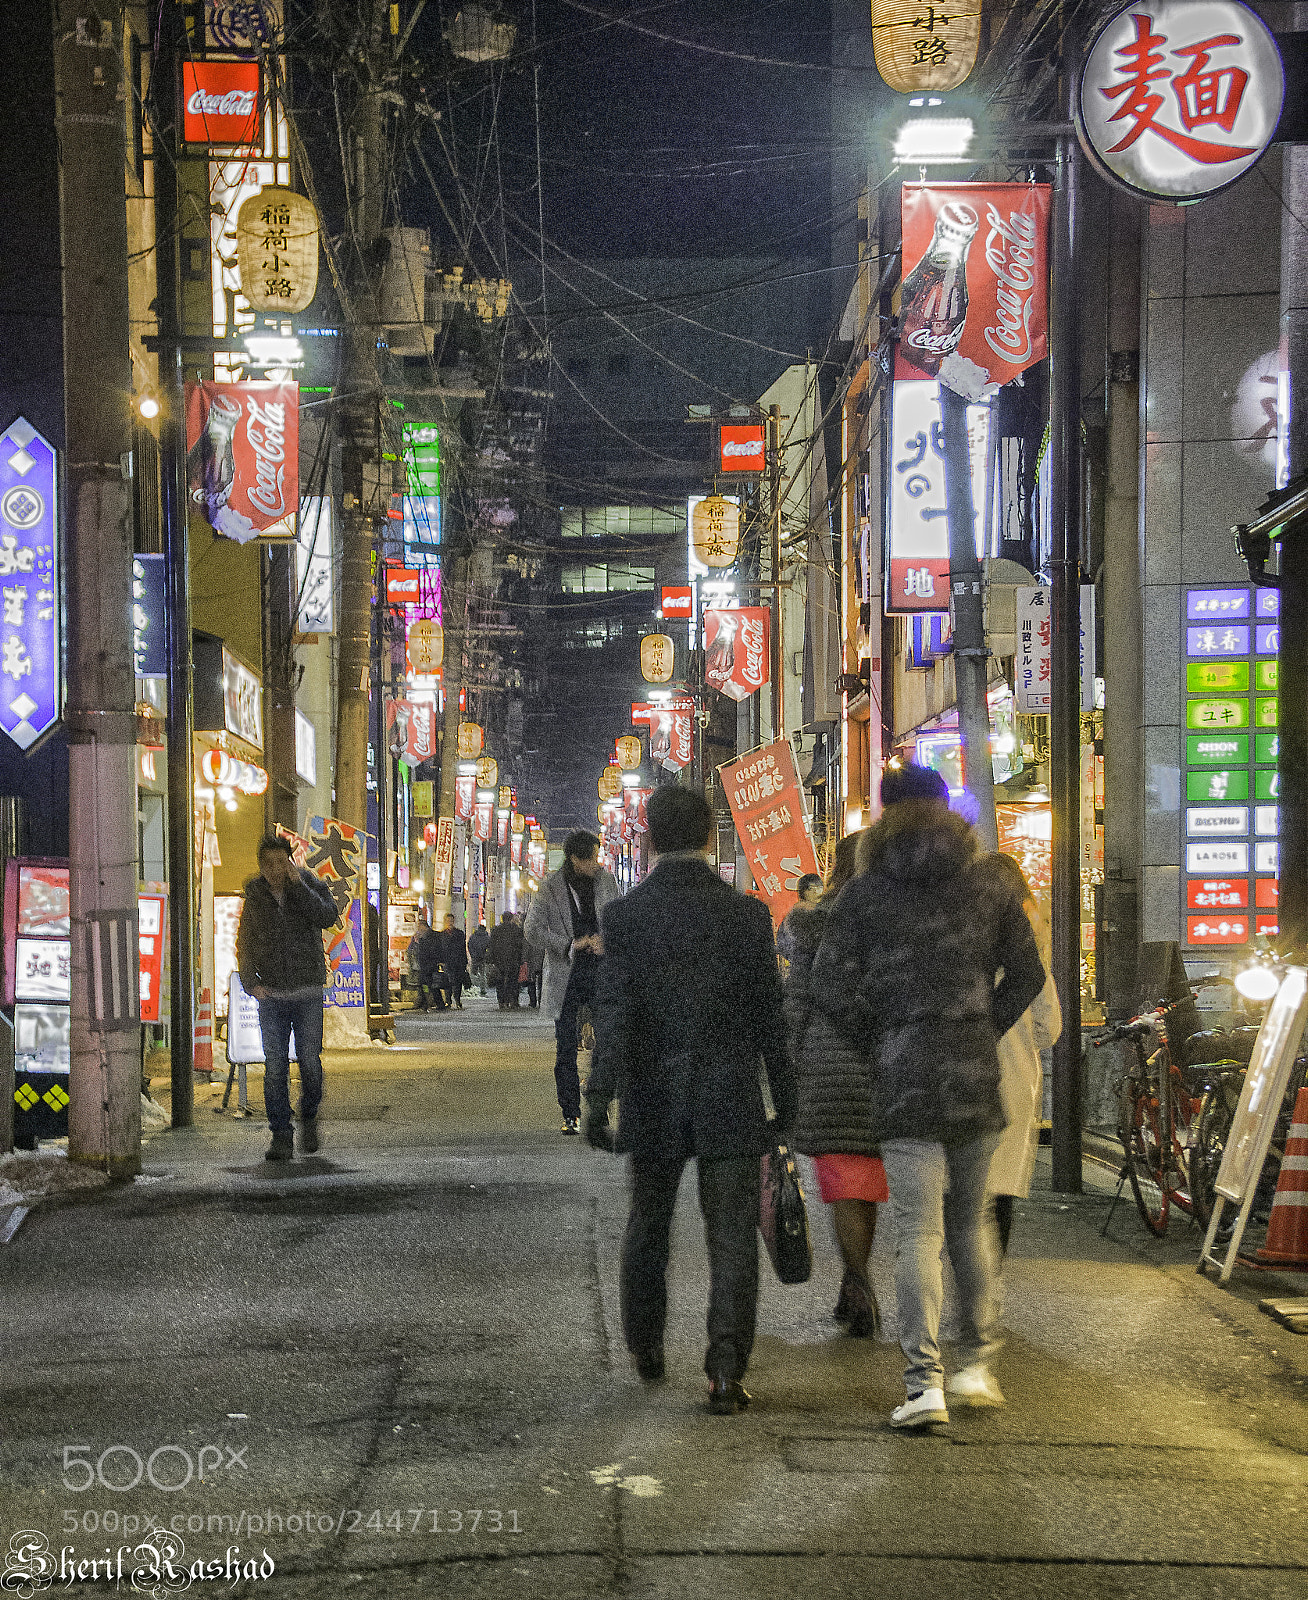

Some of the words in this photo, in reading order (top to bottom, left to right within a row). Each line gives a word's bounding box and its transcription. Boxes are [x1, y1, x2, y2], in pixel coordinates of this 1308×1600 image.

[912, 0, 953, 66] 小路
[187, 89, 257, 116] Coca-Cola
[1099, 14, 1259, 164] 麺
[260, 203, 295, 299] 稲荷小路
[984, 202, 1037, 364] Coca-Cola
[246, 395, 286, 518] Coca-Cola
[723, 441, 764, 457] Coca-Cola
[706, 504, 725, 557] 稲荷小路
[904, 567, 935, 598] 地
[1195, 597, 1245, 612] スキップ
[740, 615, 764, 686] Coca-Cola
[1021, 619, 1033, 666] 川政ビル
[1202, 708, 1234, 723] ユキ
[1197, 741, 1239, 752] SHION
[1196, 852, 1210, 860] LA
[1212, 852, 1238, 860] ROSE
